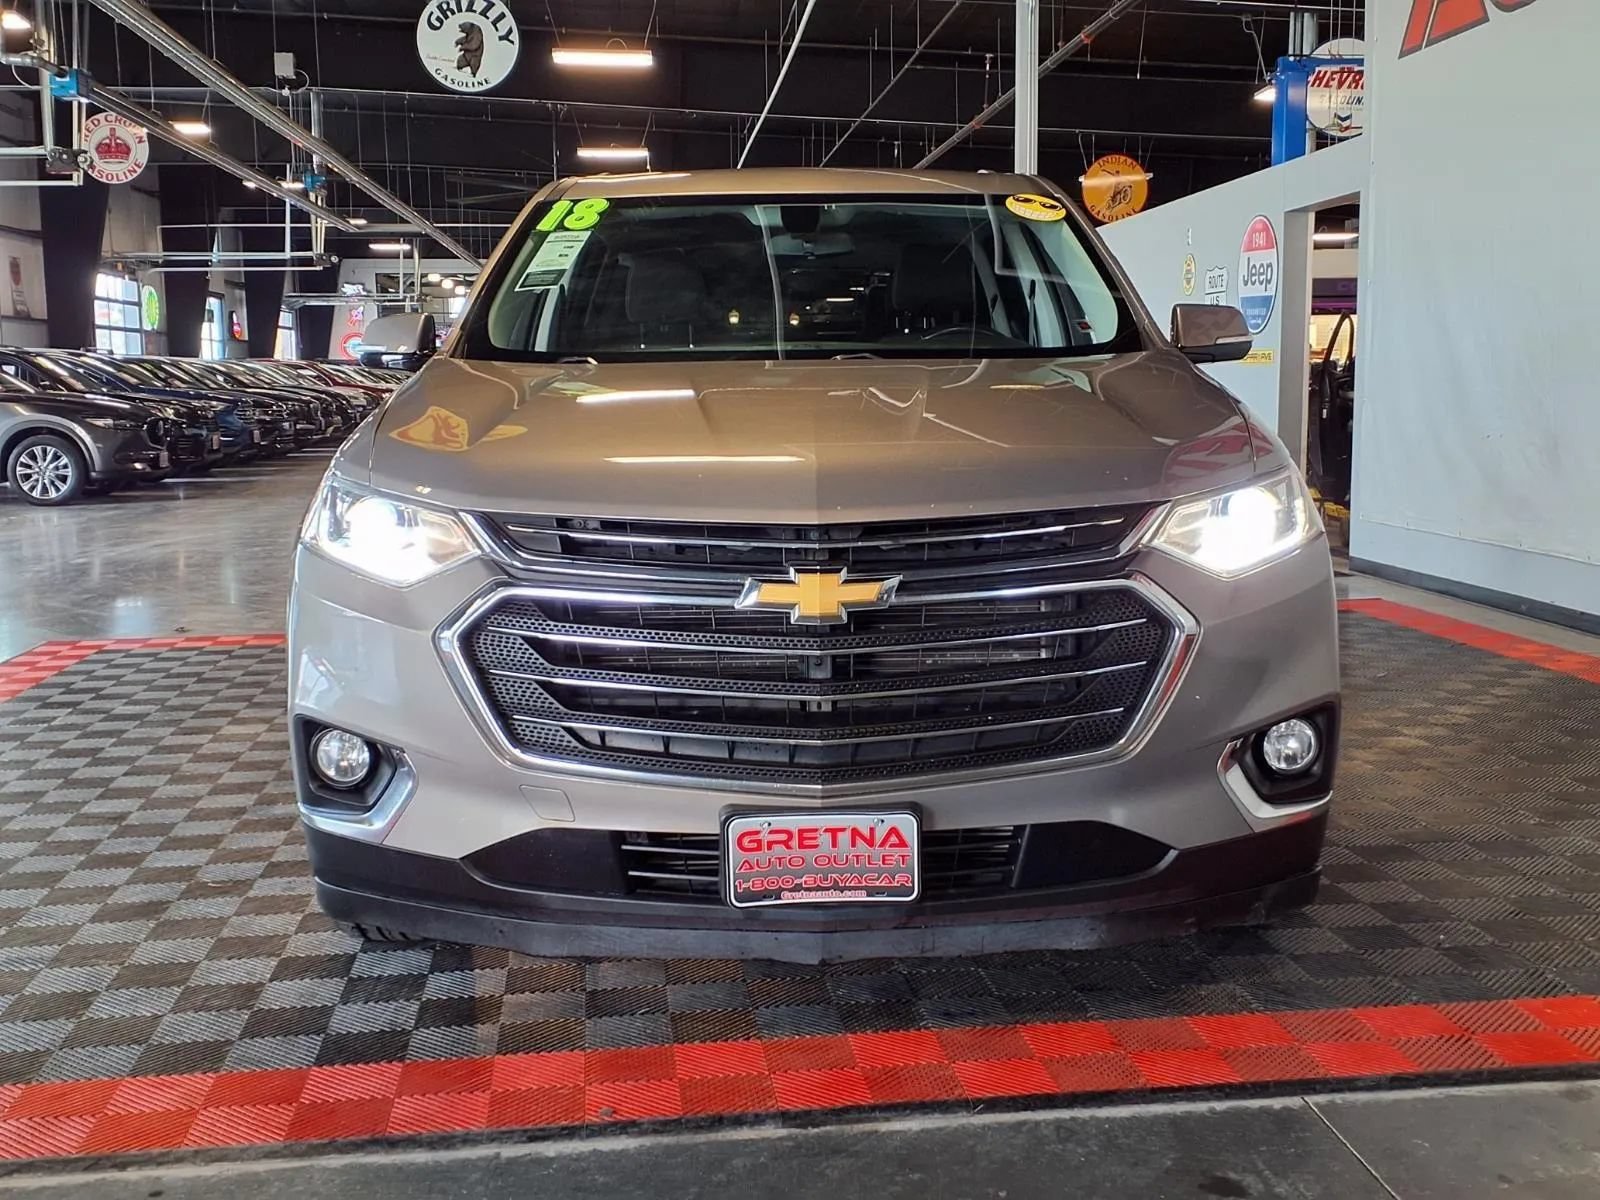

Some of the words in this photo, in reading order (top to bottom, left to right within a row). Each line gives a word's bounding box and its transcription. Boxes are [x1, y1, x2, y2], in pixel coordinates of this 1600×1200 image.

[427, 0, 515, 46] GRIZZLY
[434, 67, 491, 88] GASOLINE
[104, 113, 146, 144] CRON
[88, 158, 144, 182] ASOLINE
[1097, 156, 1137, 170] INDIAN
[535, 198, 610, 232] 18
[1252, 231, 1266, 249] 1941
[1207, 274, 1224, 289] ROUTE
[1242, 257, 1274, 292] Jeep
[736, 825, 911, 853] GRETNA
[736, 855, 805, 873] AUTO
[813, 853, 912, 868] OUTLET
[735, 873, 912, 893] 1-800-BUYACAR
